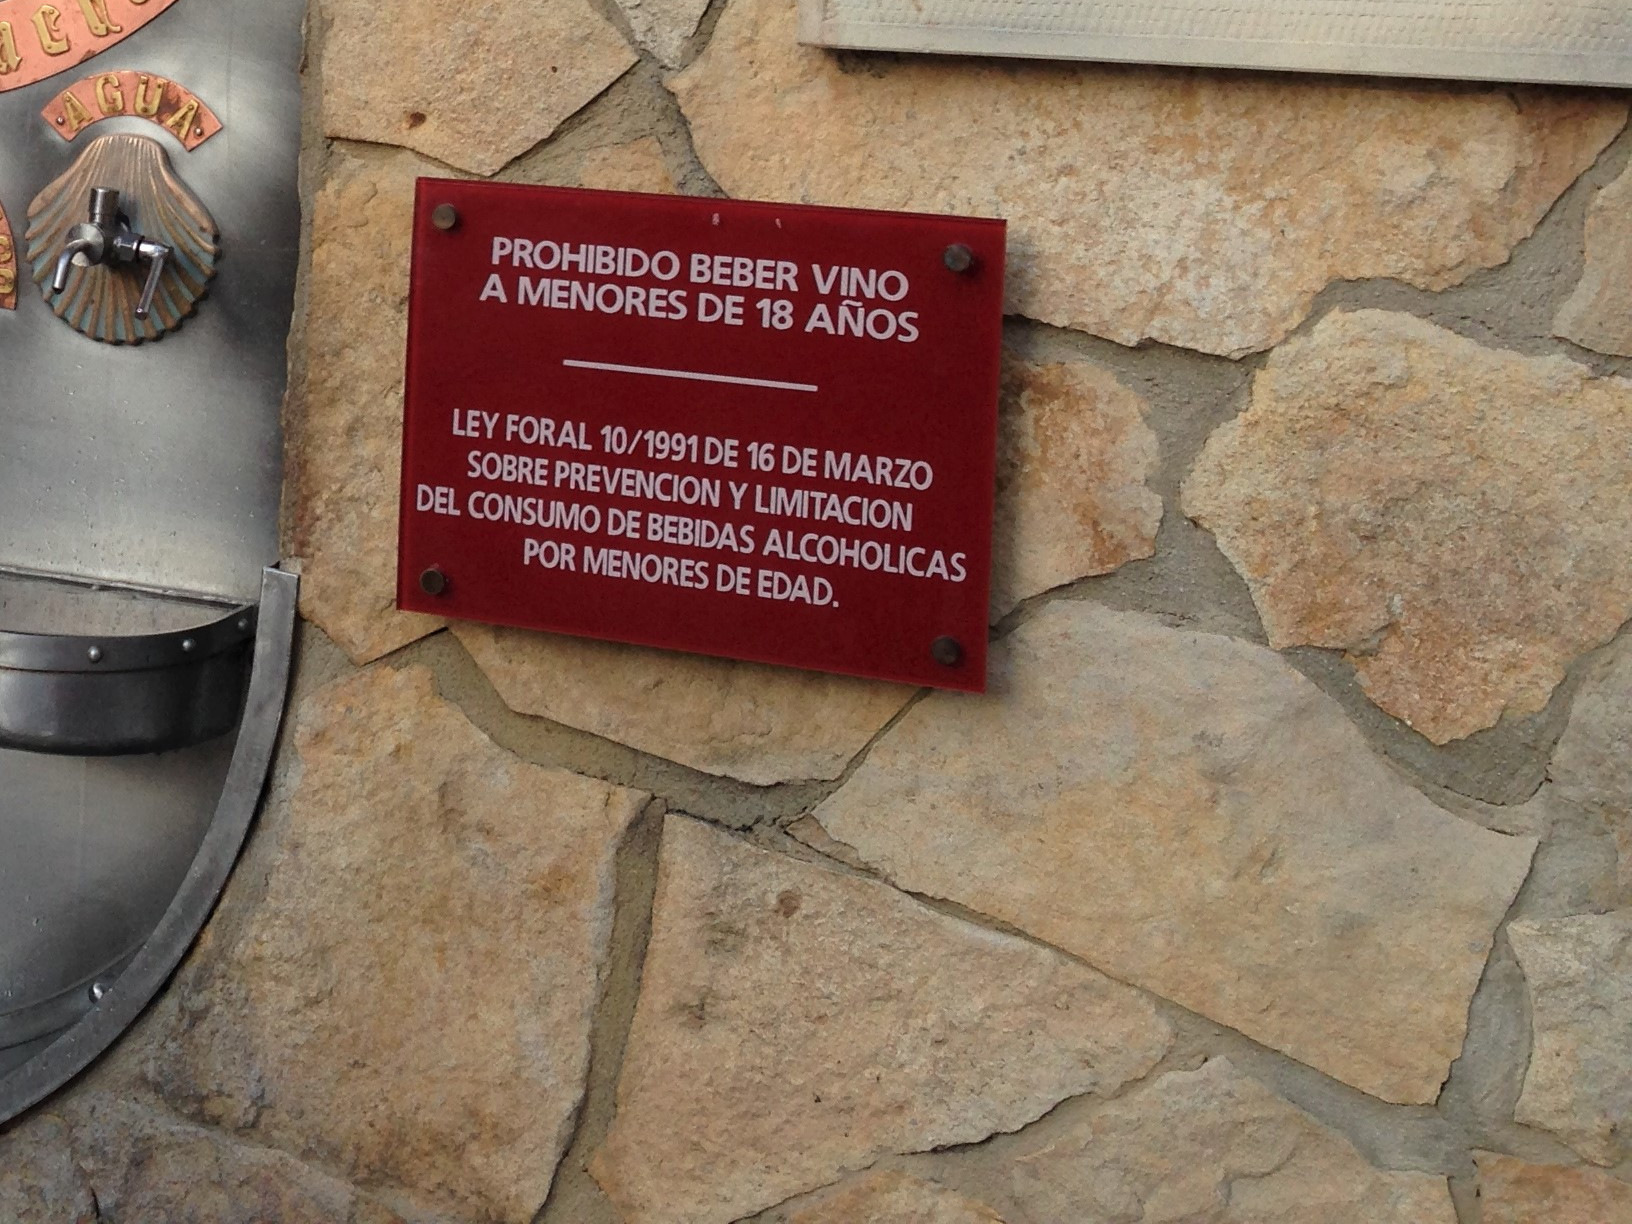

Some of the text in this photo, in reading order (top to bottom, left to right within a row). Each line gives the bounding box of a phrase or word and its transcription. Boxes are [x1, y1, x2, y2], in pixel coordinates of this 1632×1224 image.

[65, 76, 202, 137] AGUA
[492, 236, 910, 301] PROHIBIDO BEBER VINO
[480, 273, 920, 343] A MENORES DE 18 AÑOS
[453, 408, 934, 491] LEY FORAL 10/1991 DE 16 DE MARZO
[467, 451, 913, 531] SOBRE PREVENCION Y LIMITACION
[416, 484, 967, 582] DEL CONSUMO DE BEBIDAS ALCOHOLICAS
[524, 539, 839, 608] POR MENORES DE EDAD.
